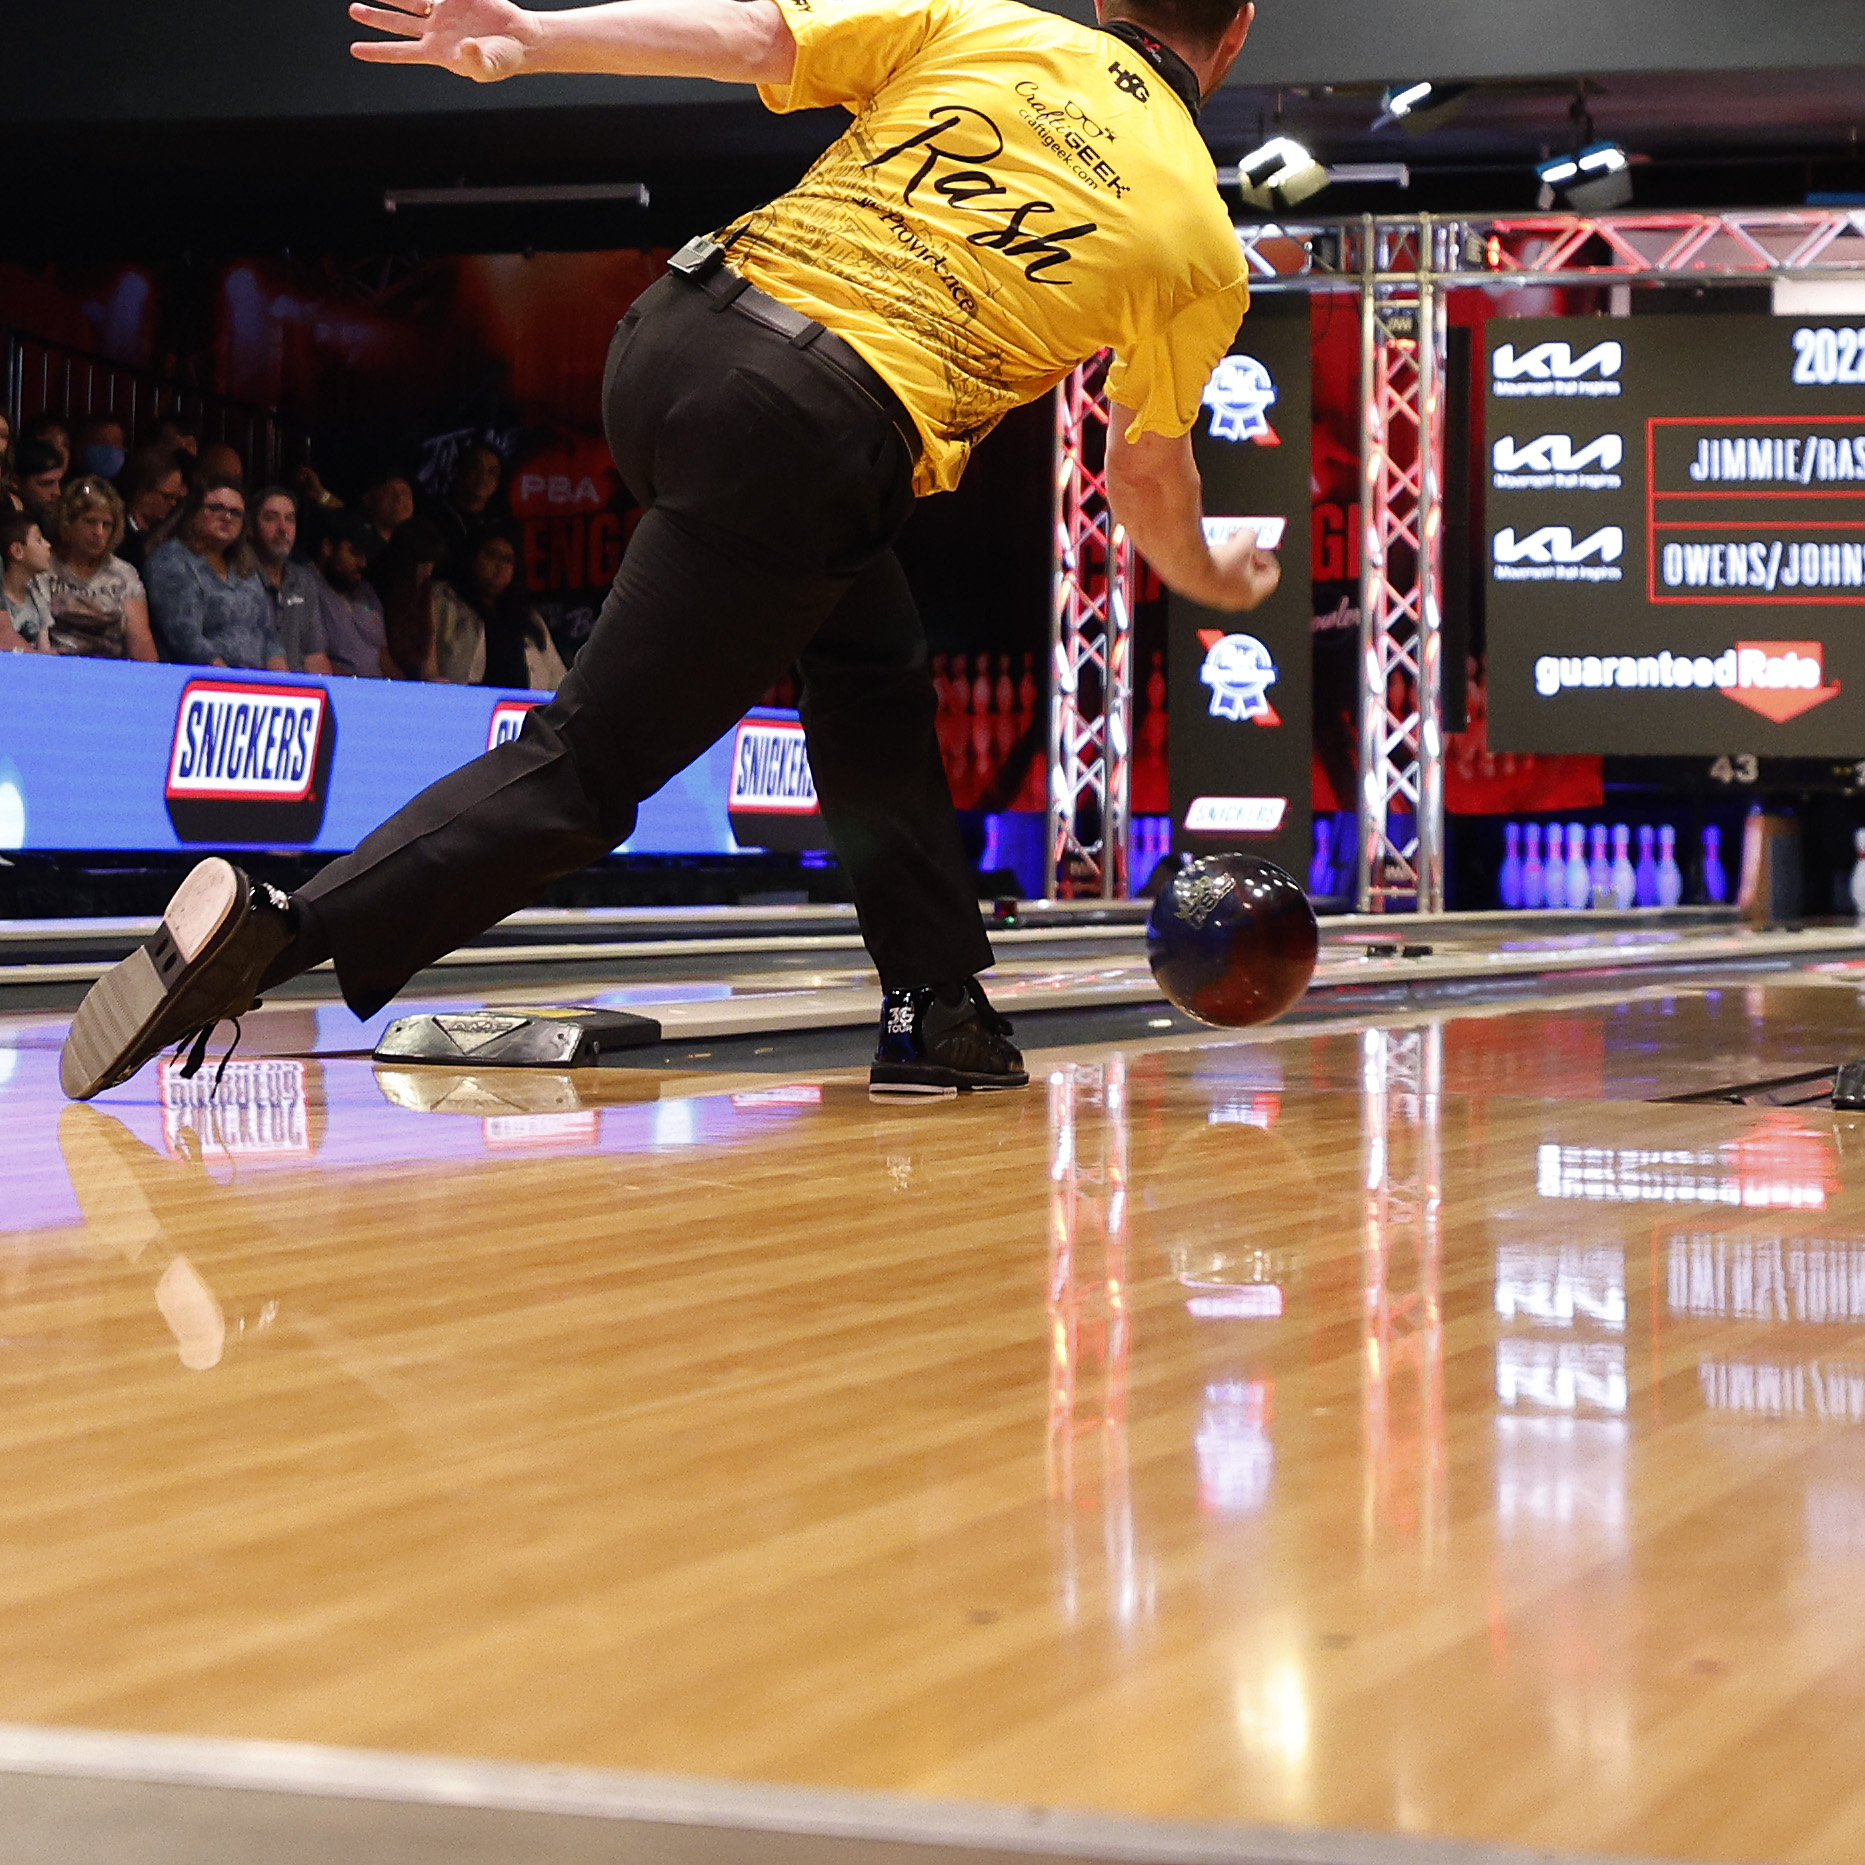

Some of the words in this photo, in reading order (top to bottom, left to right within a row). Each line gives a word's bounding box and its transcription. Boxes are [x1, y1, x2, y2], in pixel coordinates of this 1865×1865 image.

[1019, 109, 1098, 190] craftigeek.com
[861, 105, 1099, 285] Rash
[520, 473, 600, 503] PBA
[179, 700, 314, 782] SNICKERS
[1710, 751, 1759, 784] 43
[887, 1023, 913, 1034] TOUR
[888, 1005, 915, 1024] 3G
